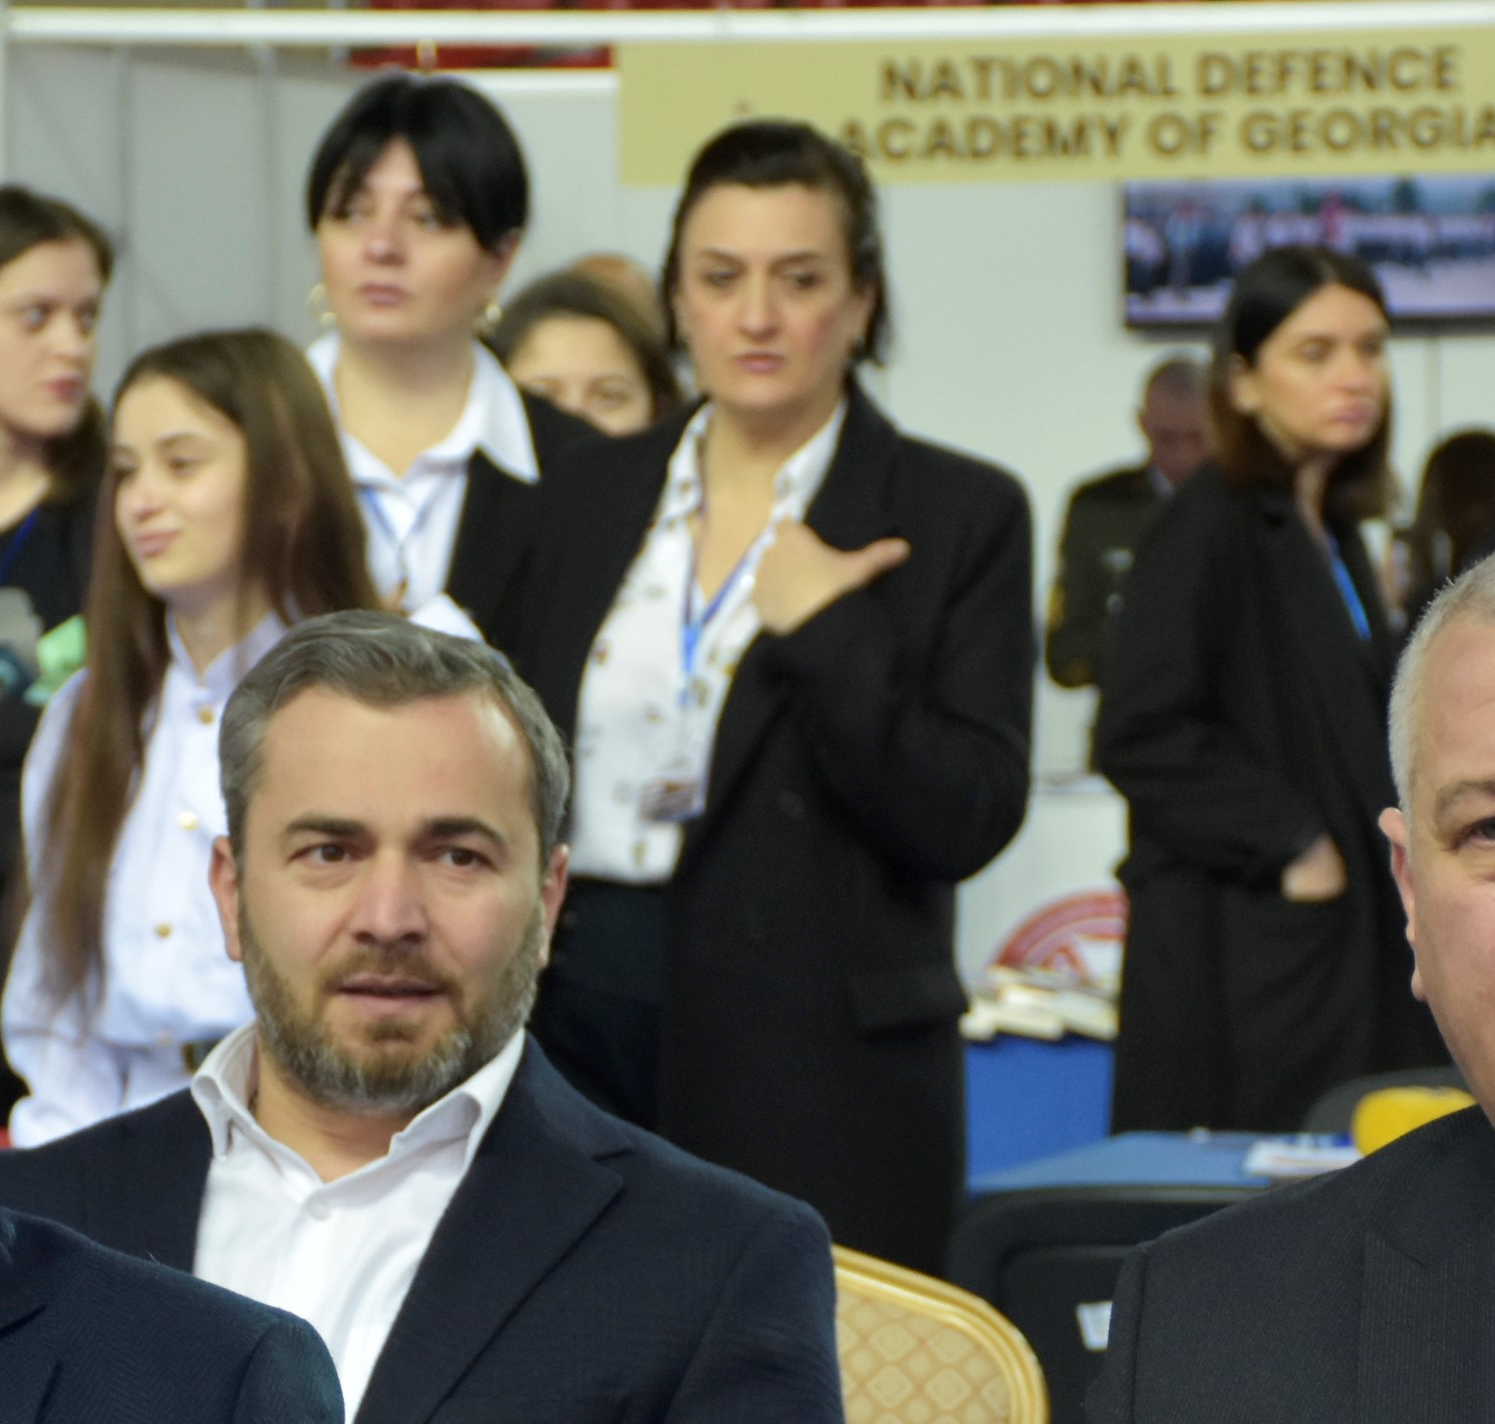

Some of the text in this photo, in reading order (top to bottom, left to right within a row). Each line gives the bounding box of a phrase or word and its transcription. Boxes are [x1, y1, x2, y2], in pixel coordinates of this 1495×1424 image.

[881, 45, 1459, 101] NATIONAL DEFENCE
[840, 111, 1129, 160] ACADEMY
[1147, 111, 1222, 158] OF
